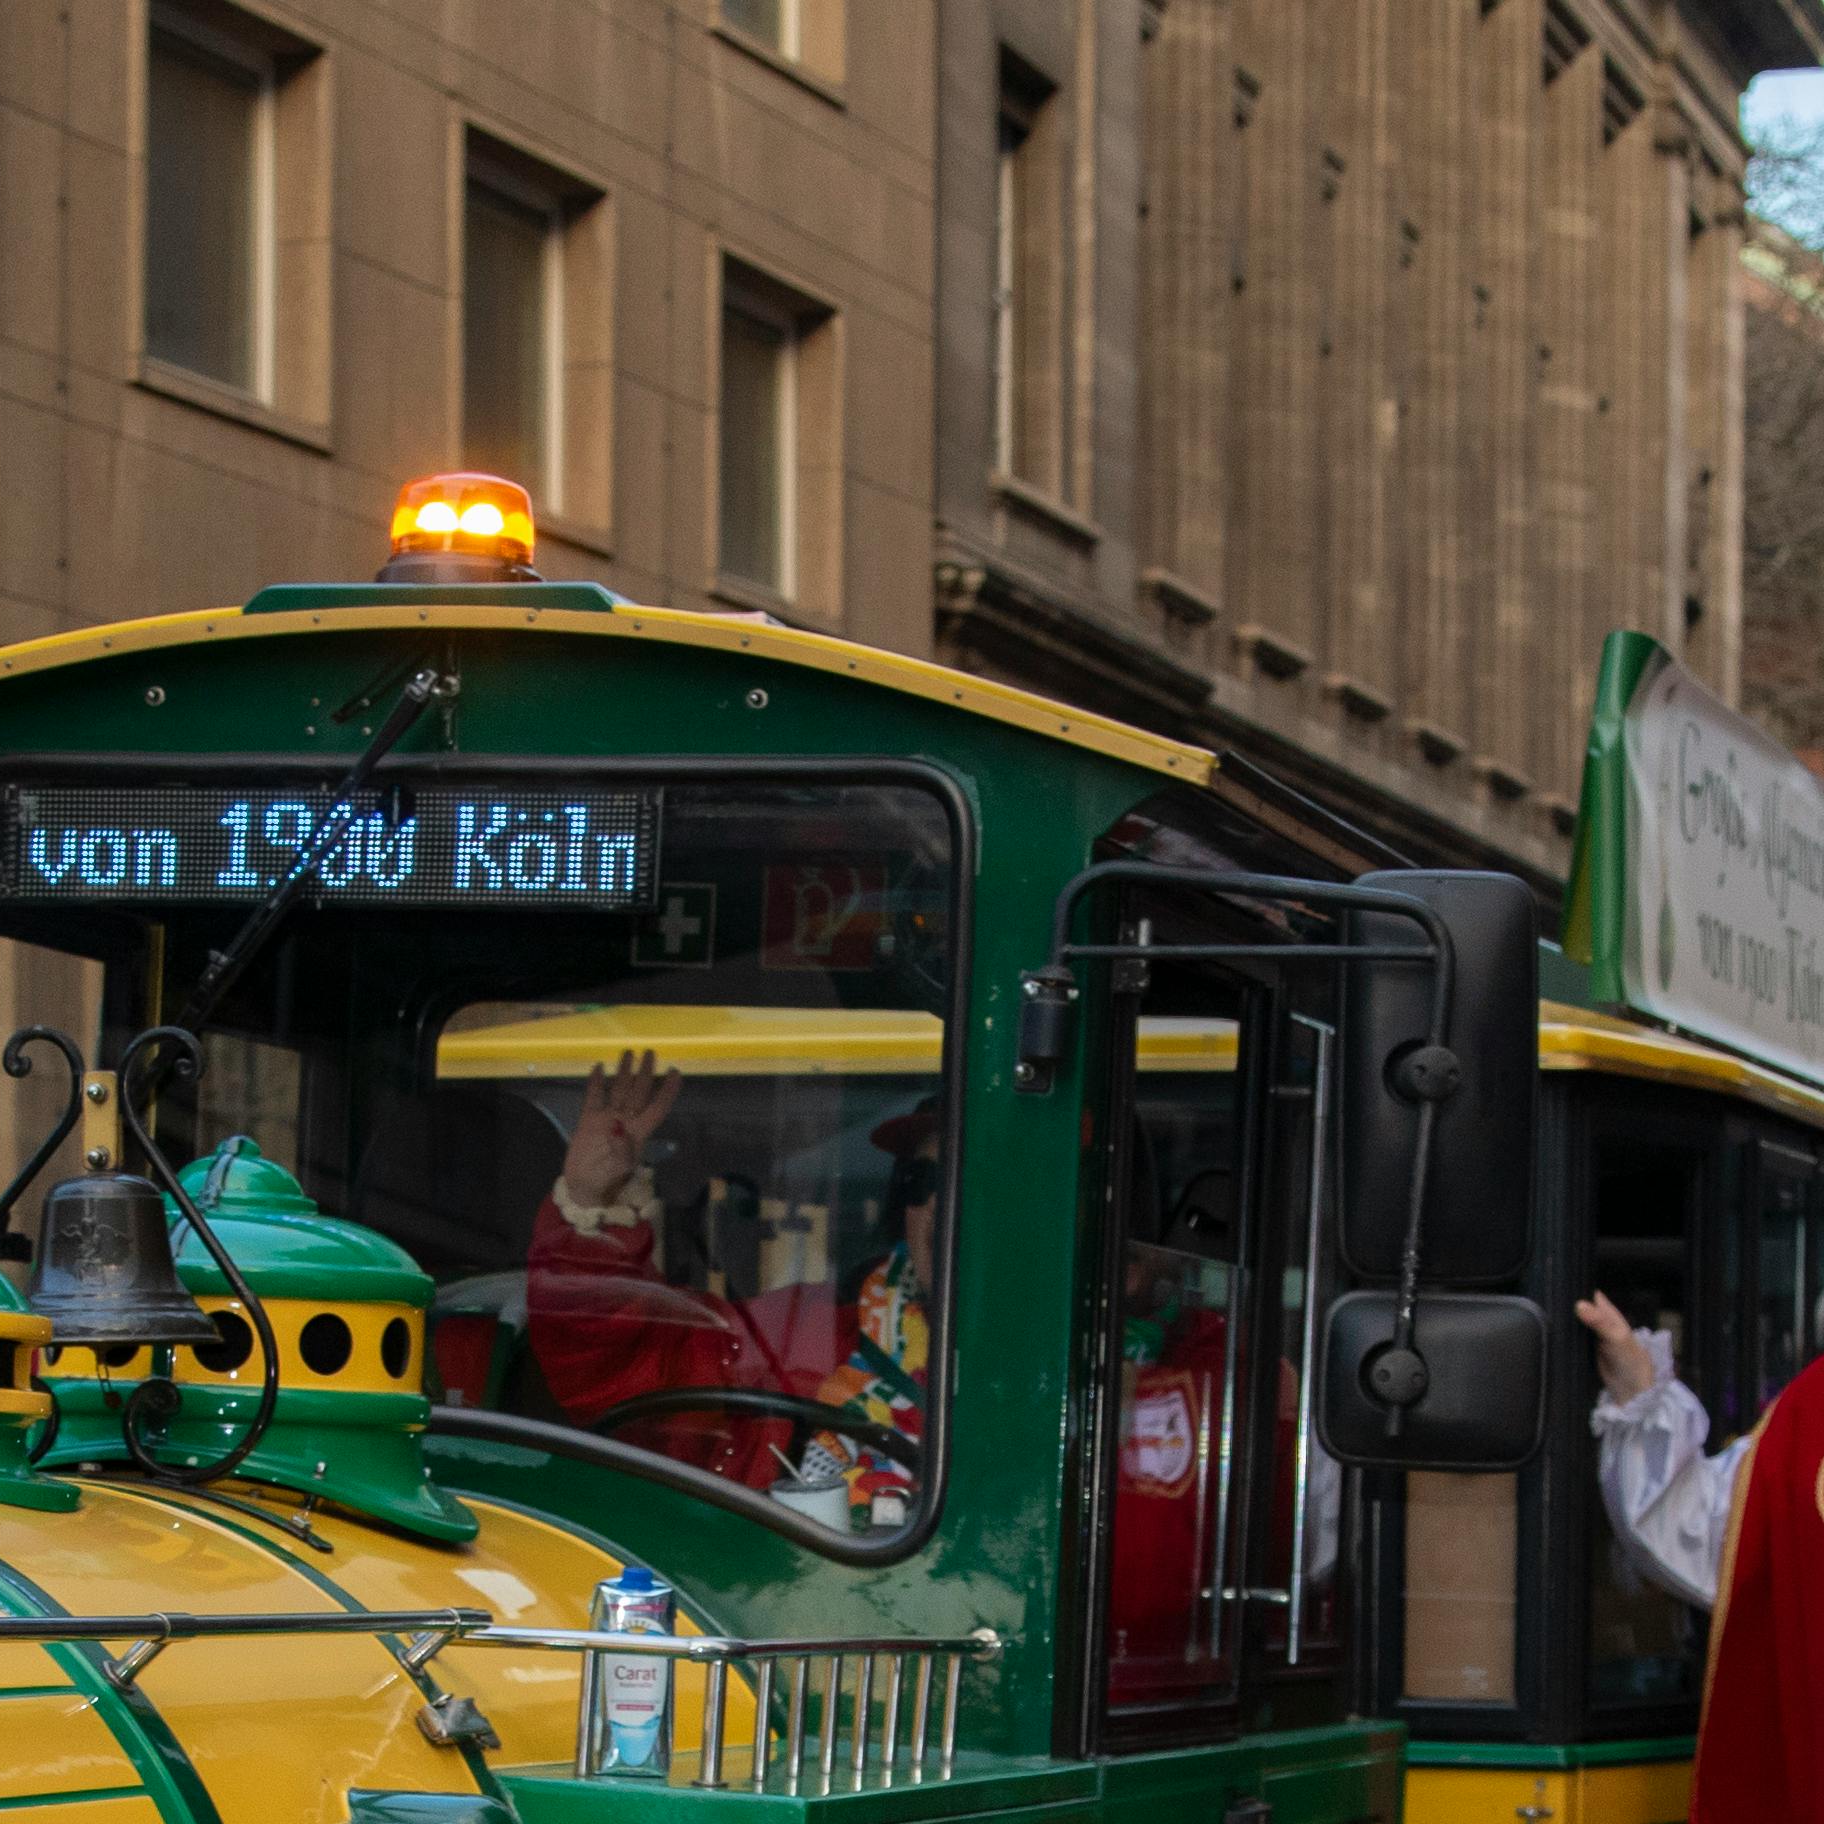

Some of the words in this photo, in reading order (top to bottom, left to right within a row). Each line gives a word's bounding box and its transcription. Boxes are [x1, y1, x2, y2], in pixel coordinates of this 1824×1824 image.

[27, 828, 177, 886] von
[453, 803, 635, 891] Köln
[614, 1665, 657, 1681] Carat
